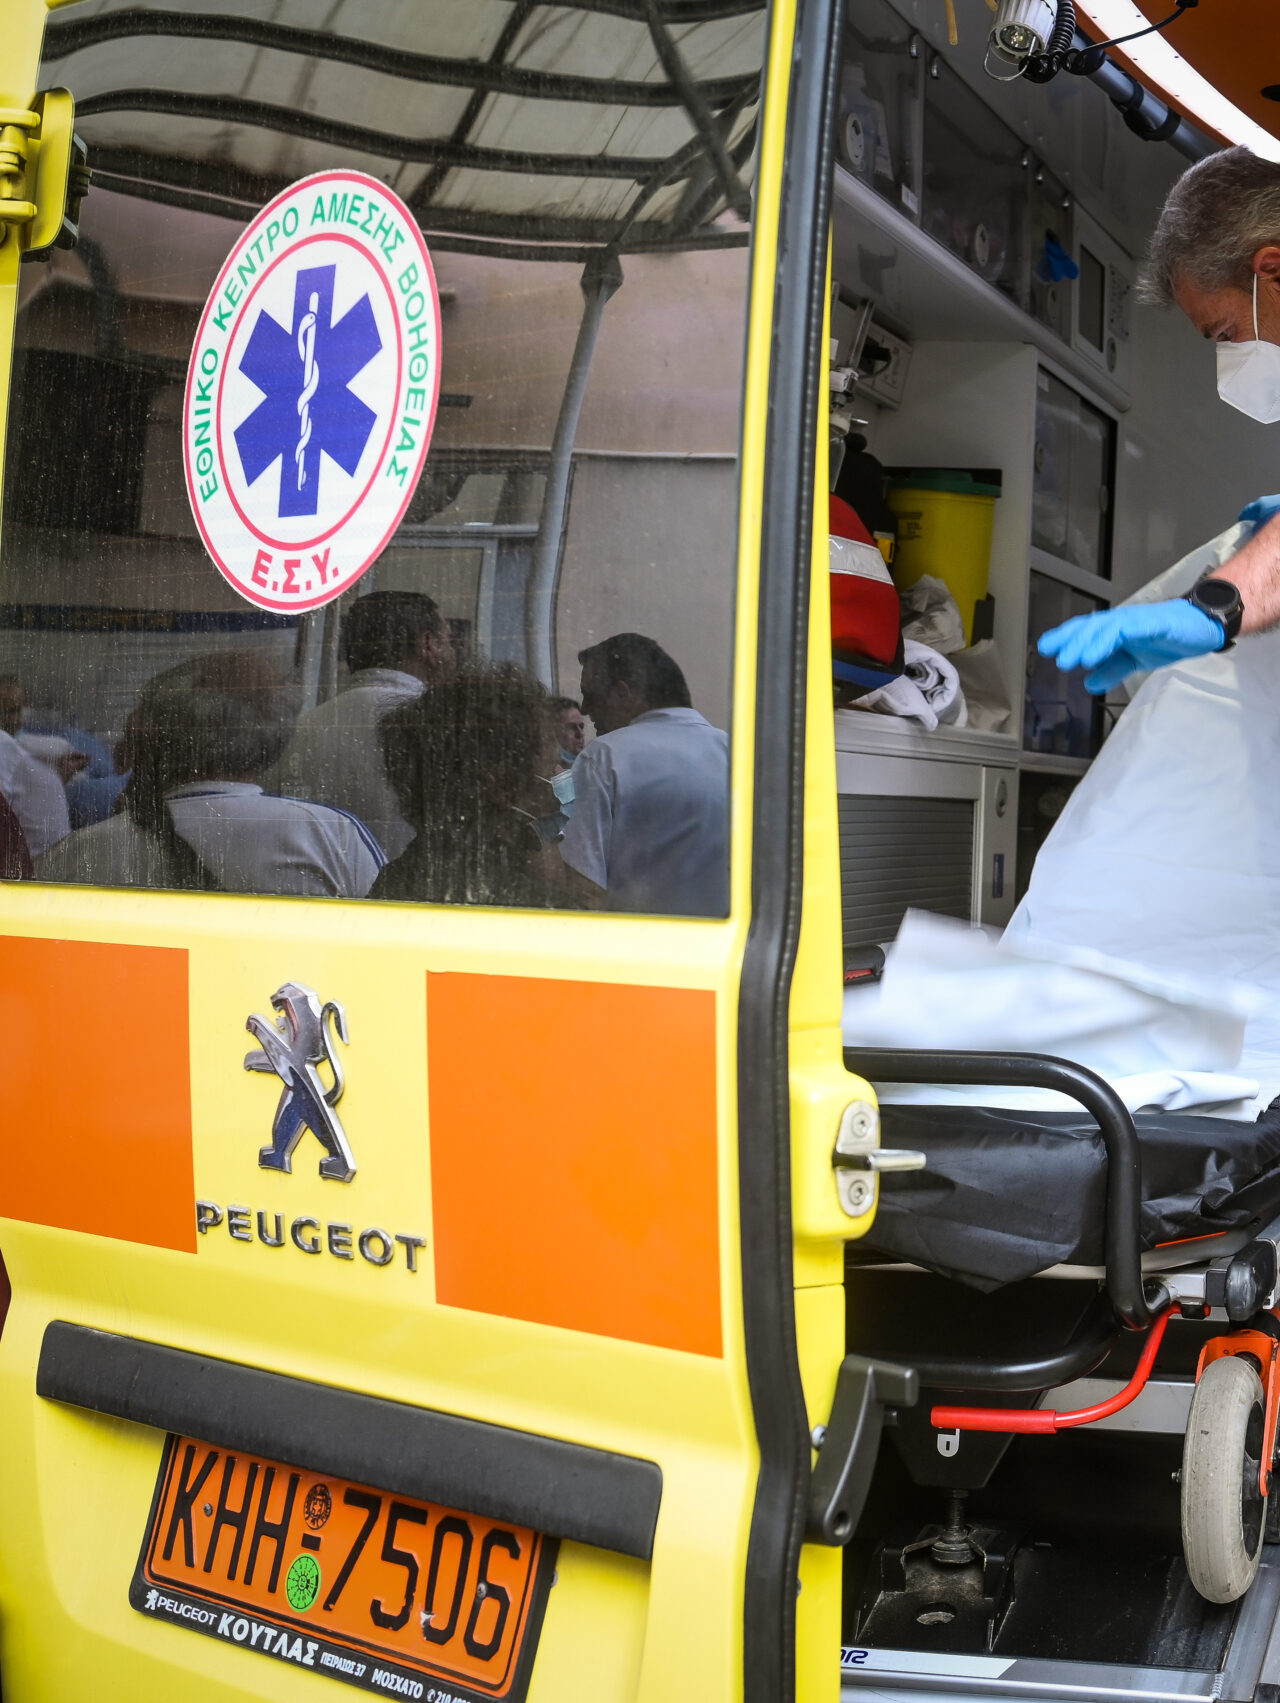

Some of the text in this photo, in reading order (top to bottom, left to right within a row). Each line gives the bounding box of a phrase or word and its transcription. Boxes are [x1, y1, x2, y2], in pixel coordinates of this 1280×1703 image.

[194, 192, 429, 503] ΕΘΝΙΚΟ ΚΕΝΤΡΟ ΑΜΕΣΗΣ ΒΟΗΘΕΙΑΣ
[250, 547, 340, 594] Ε.Σ.Υ.
[195, 1199, 427, 1273] PEUGEOT
[156, 1596, 218, 1626] PEUGEOT
[217, 1612, 320, 1666] ΚΟΥΤΛΑΣ
[355, 1663, 367, 1677] 37
[371, 1668, 424, 1699] ΜΟΣΧΑΤΟ
